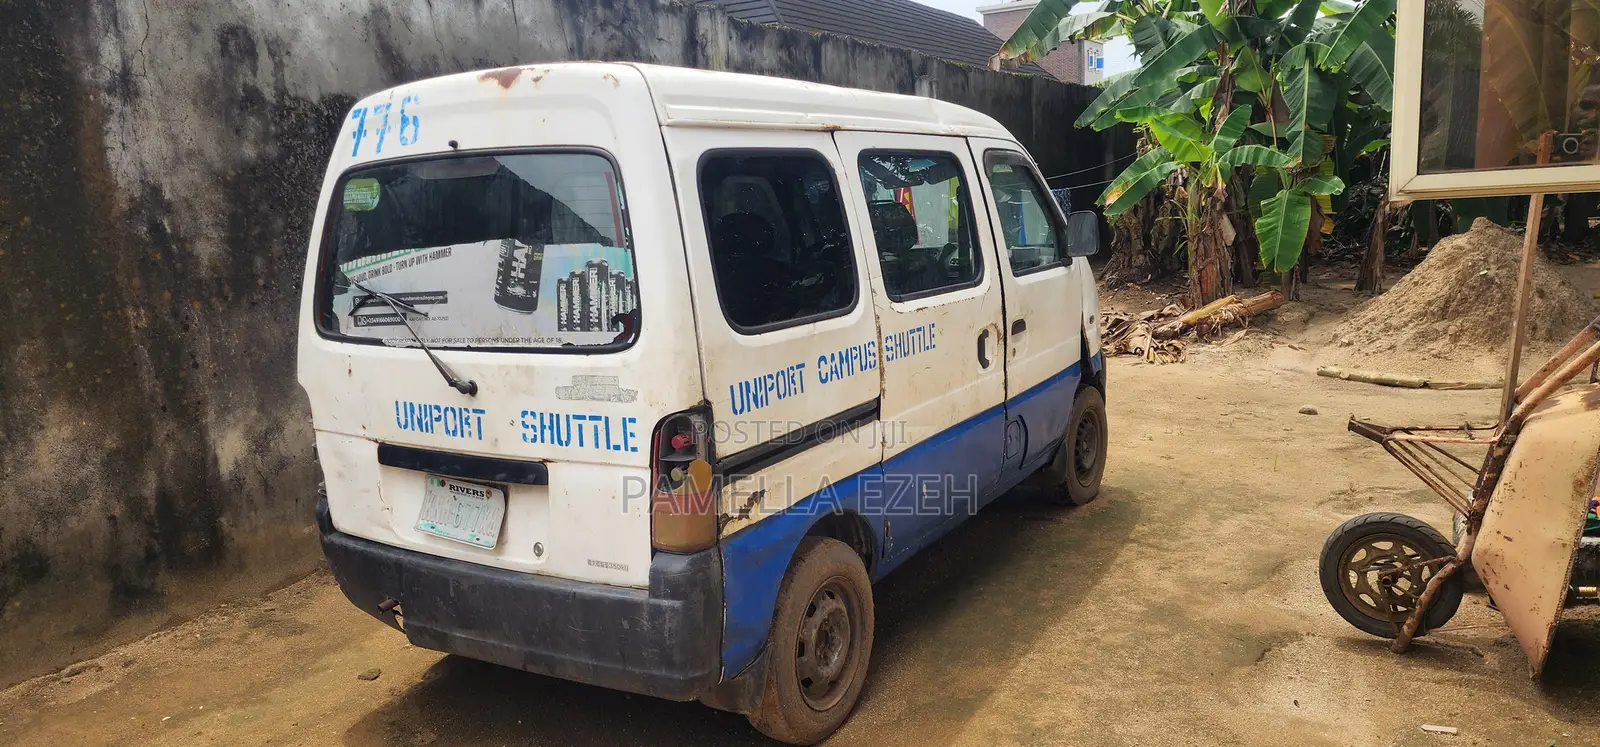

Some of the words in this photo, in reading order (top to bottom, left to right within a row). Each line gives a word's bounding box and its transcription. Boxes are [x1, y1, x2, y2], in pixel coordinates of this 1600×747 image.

[352, 95, 420, 157] 776
[428, 247, 452, 263] HAMMER
[728, 362, 806, 416] UNIPORT
[817, 340, 877, 385] CAMPUS
[884, 322, 937, 362] SHUTTLE
[394, 400, 486, 441] UNIPORT
[520, 409, 639, 453] SHUTTLE
[449, 483, 485, 498] RIVERS
